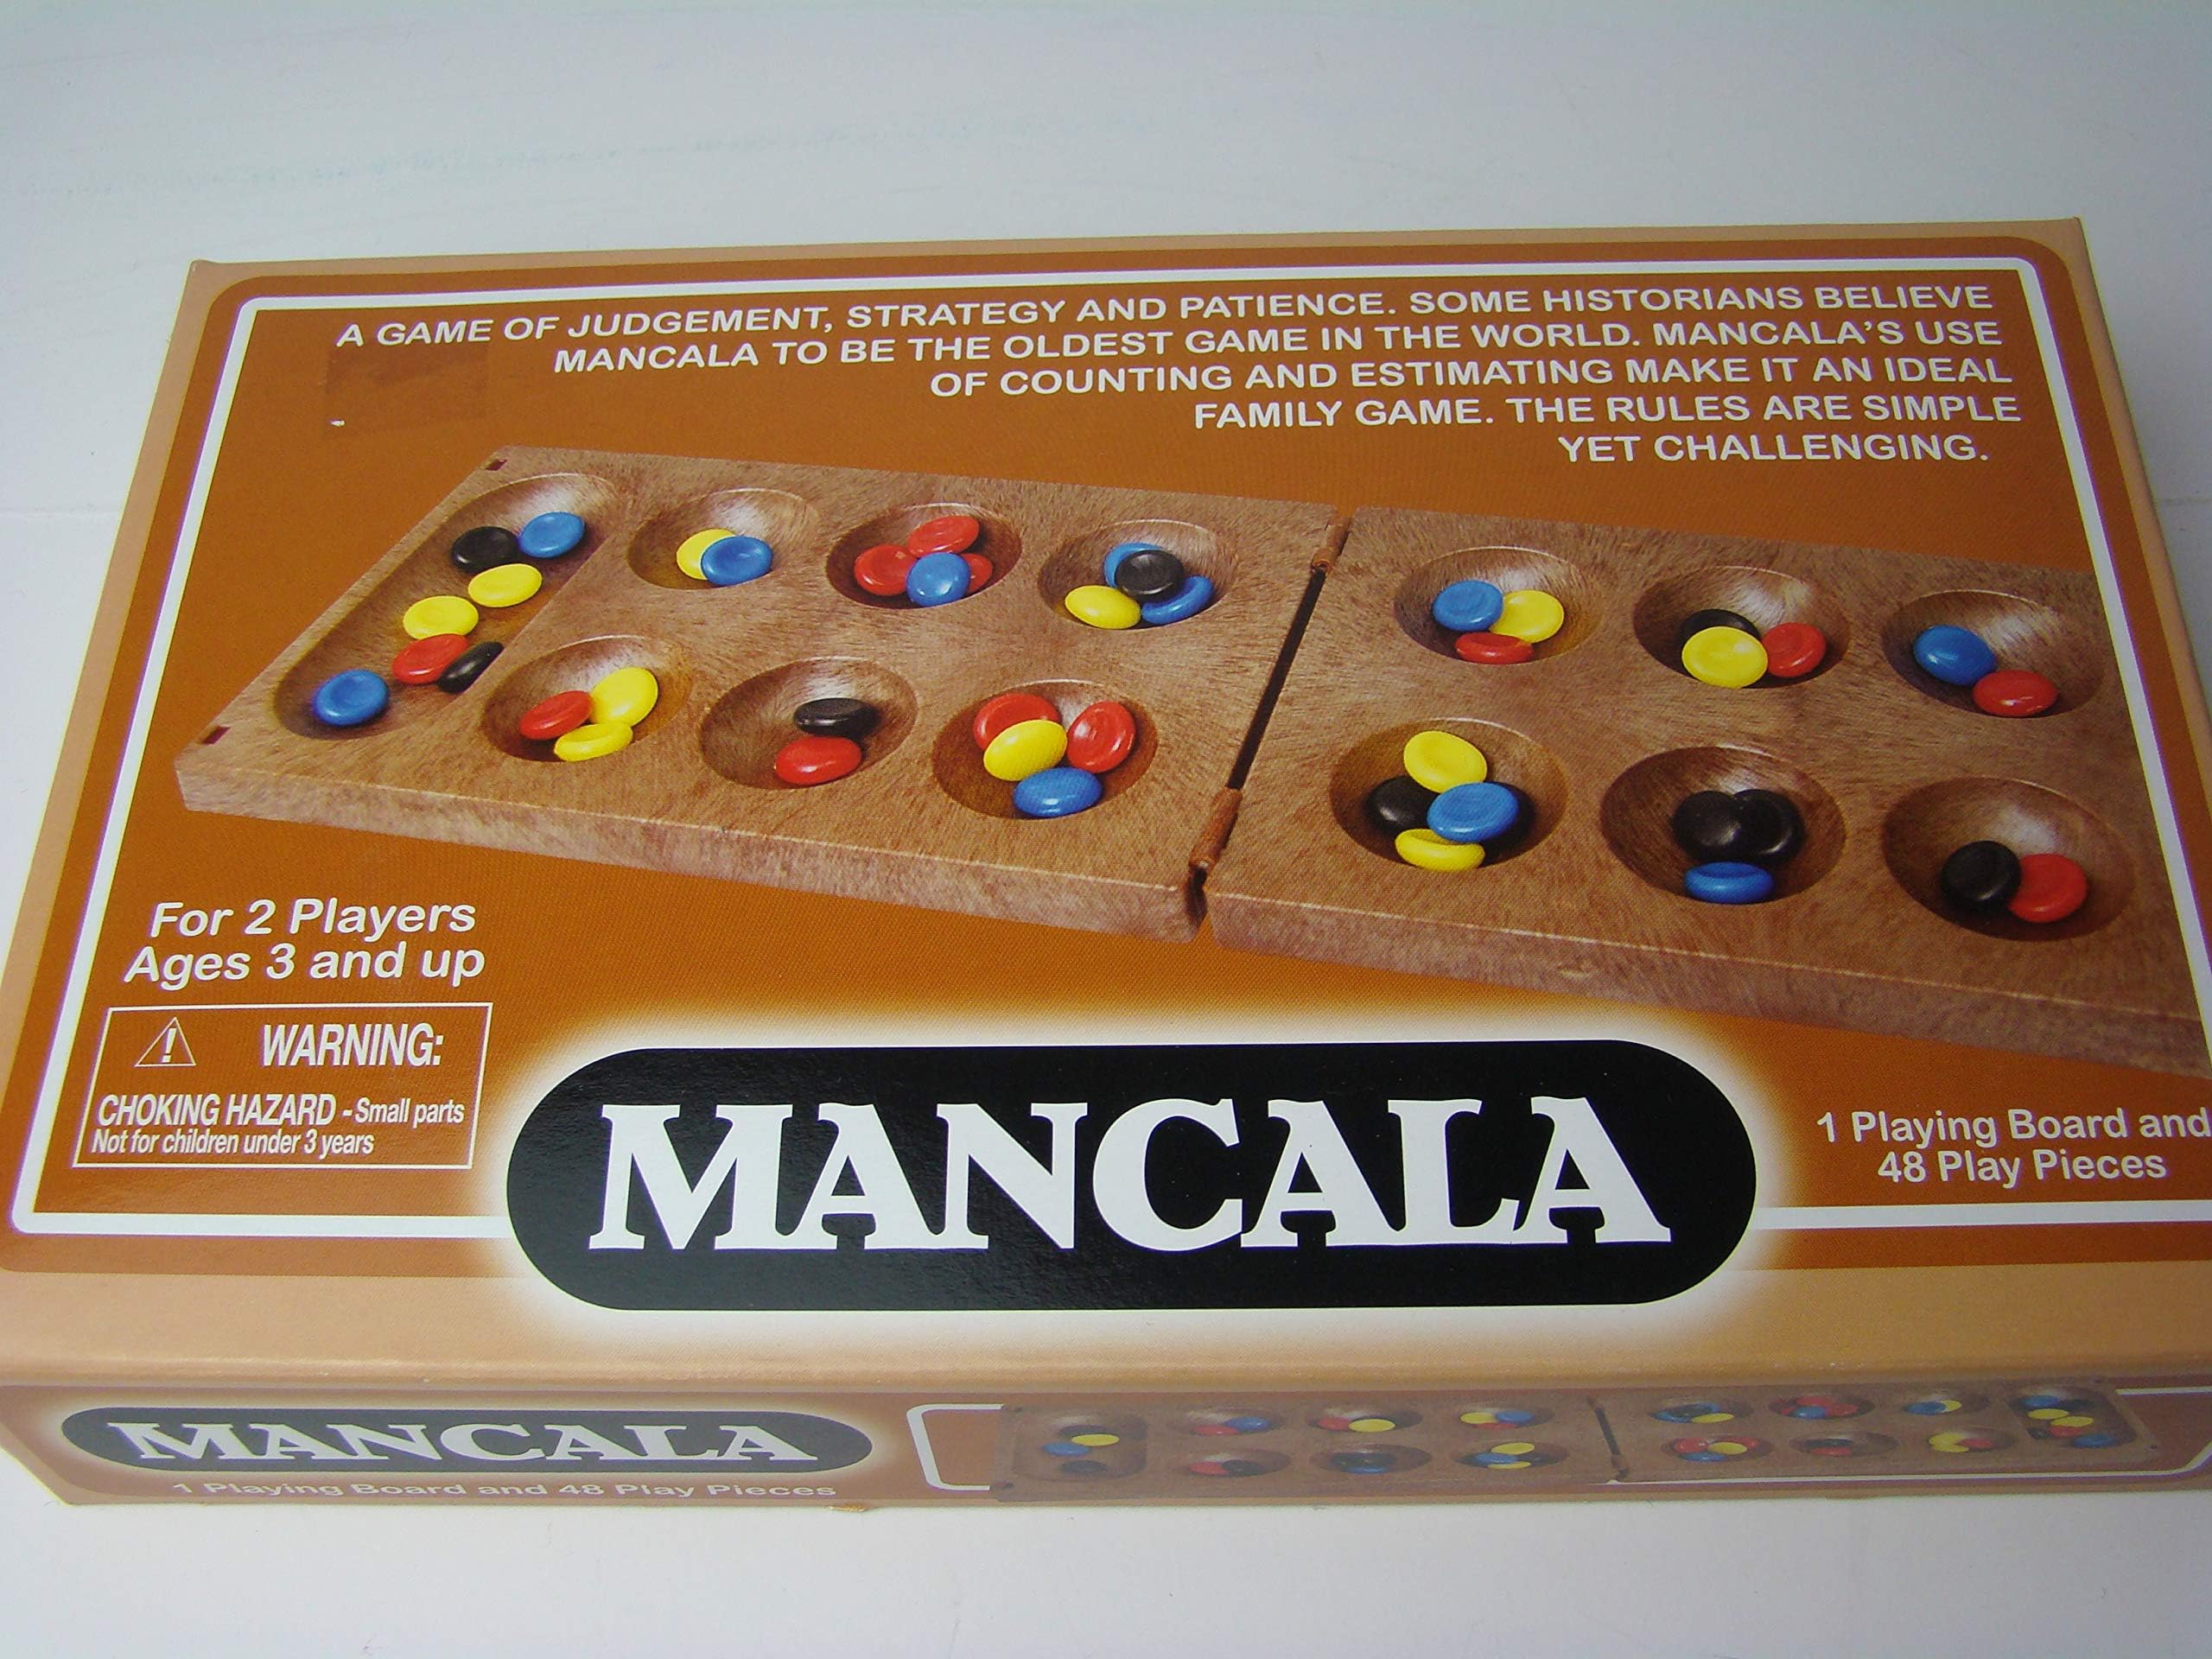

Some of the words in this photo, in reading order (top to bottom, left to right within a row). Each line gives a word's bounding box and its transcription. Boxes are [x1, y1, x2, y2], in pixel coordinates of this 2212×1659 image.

[335, 323, 364, 346] A
[376, 318, 494, 346] GAME
[503, 315, 560, 340] OF
[567, 306, 832, 338] JUDGEMENT,
[847, 299, 1066, 328] STRATEGY
[1077, 297, 1166, 322] AND
[1180, 291, 1396, 319] PATIENCE.
[1409, 289, 1532, 314] SOME
[1542, 286, 1804, 312] HISTORIANS
[1815, 285, 1993, 308] BELIEVE
[554, 342, 759, 373] MANCALA
[772, 340, 828, 365] TO
[840, 338, 896, 363] BE
[907, 335, 991, 361] THE
[1003, 331, 1173, 359] OLDEST
[1185, 327, 1308, 353] GAME
[1321, 326, 1363, 351] IN
[1374, 324, 1461, 349] THE
[1471, 322, 1640, 348] WORLD.
[1653, 320, 1905, 346] MANCALA'S
[1915, 320, 2005, 345] USE
[931, 372, 988, 397] OF
[1000, 365, 1232, 395] COUNTING
[1245, 363, 1338, 389] AND
[1351, 359, 1613, 387] ESTIMATING
[1625, 357, 1751, 384] MAKE
[1761, 357, 1799, 382] IT
[1813, 357, 1873, 382] AN
[1884, 357, 2013, 383] IDEAL
[1195, 400, 1343, 429] FAMILY
[1355, 398, 1494, 426] GAME.
[1505, 397, 1595, 423] THE
[1606, 395, 1751, 423] RULES
[1764, 395, 1853, 421] ARE
[1862, 394, 2022, 422] SIMPLE
[1558, 435, 1642, 462] YET
[1654, 434, 1988, 461] CHALLENGING.
[148, 902, 234, 938] For
[243, 899, 276, 935] 2
[287, 897, 476, 943] Players
[122, 945, 251, 991] Ages
[265, 943, 296, 980] 3
[308, 940, 407, 979] and
[420, 949, 485, 988] up
[261, 1022, 444, 1067] WARNING:
[95, 1093, 220, 1127] CHOKING
[224, 1093, 336, 1126] HAZARD
[412, 1099, 465, 1129] parts
[1817, 1111, 1837, 1143] 1
[1852, 1109, 2000, 1149] Playing
[2007, 1108, 2130, 1140] Board
[2139, 1107, 2212, 1138] and
[90, 1128, 129, 1154] Not
[129, 1128, 161, 1154] for
[160, 1128, 239, 1154] children
[241, 1128, 302, 1154] under
[303, 1128, 317, 1154] 3
[317, 1134, 375, 1160] years
[587, 1096, 1672, 1253] MANCALA
[1878, 1151, 1928, 1183] 48
[1937, 1149, 2021, 1190] Play
[2032, 1148, 2170, 1180] Pieces
[105, 1422, 818, 1462] MANCALA
[172, 1483, 193, 1494] 1
[203, 1483, 344, 1497] Playing
[350, 1484, 467, 1496] Board
[477, 1484, 548, 1495] and
[558, 1484, 605, 1496] 48
[614, 1484, 695, 1498] Play
[707, 1484, 836, 1496] Pieces
